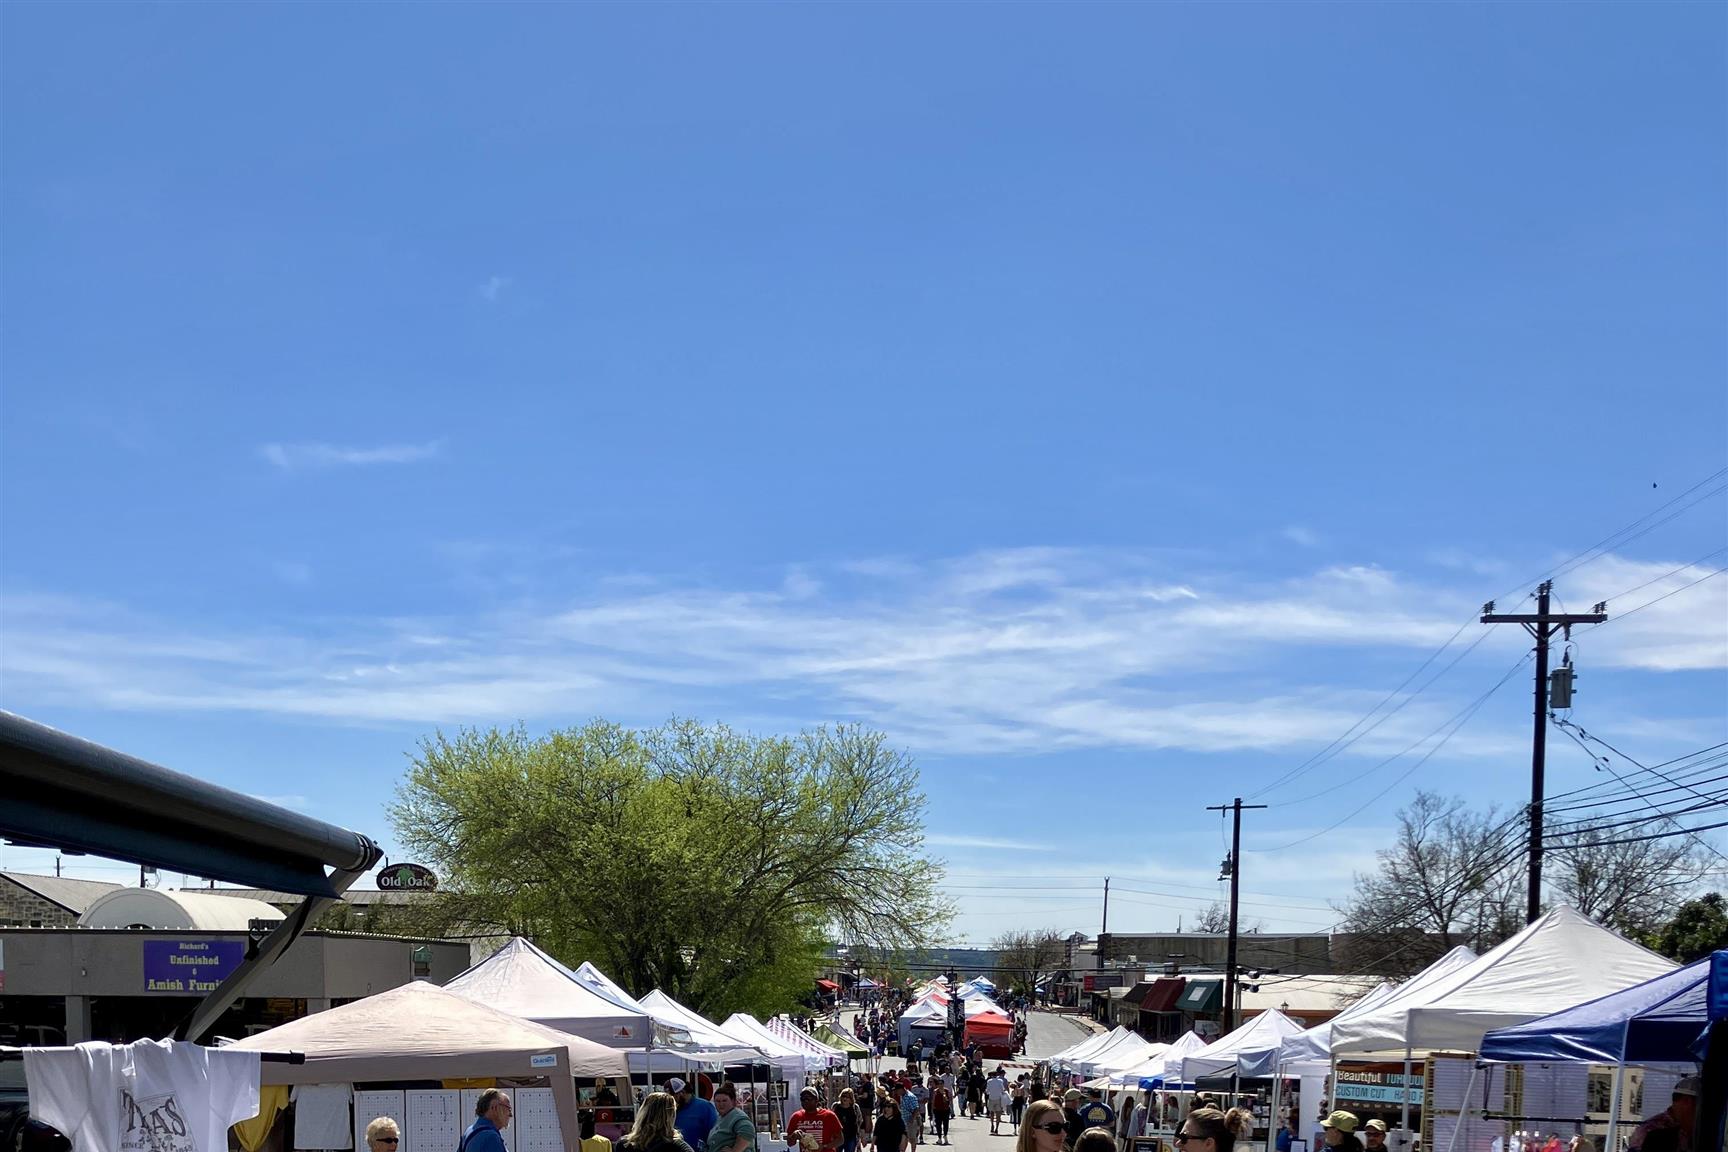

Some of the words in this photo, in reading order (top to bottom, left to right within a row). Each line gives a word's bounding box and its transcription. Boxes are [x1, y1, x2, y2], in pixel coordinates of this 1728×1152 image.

[381, 876, 401, 887] Old
[407, 876, 431, 887] Oak
[170, 954, 219, 965] Unfinished
[148, 979, 184, 991] Amish
[1338, 1070, 1382, 1084] Beautiful
[1336, 1086, 1368, 1098] CUSTOM
[1370, 1088, 1386, 1099] CUT
